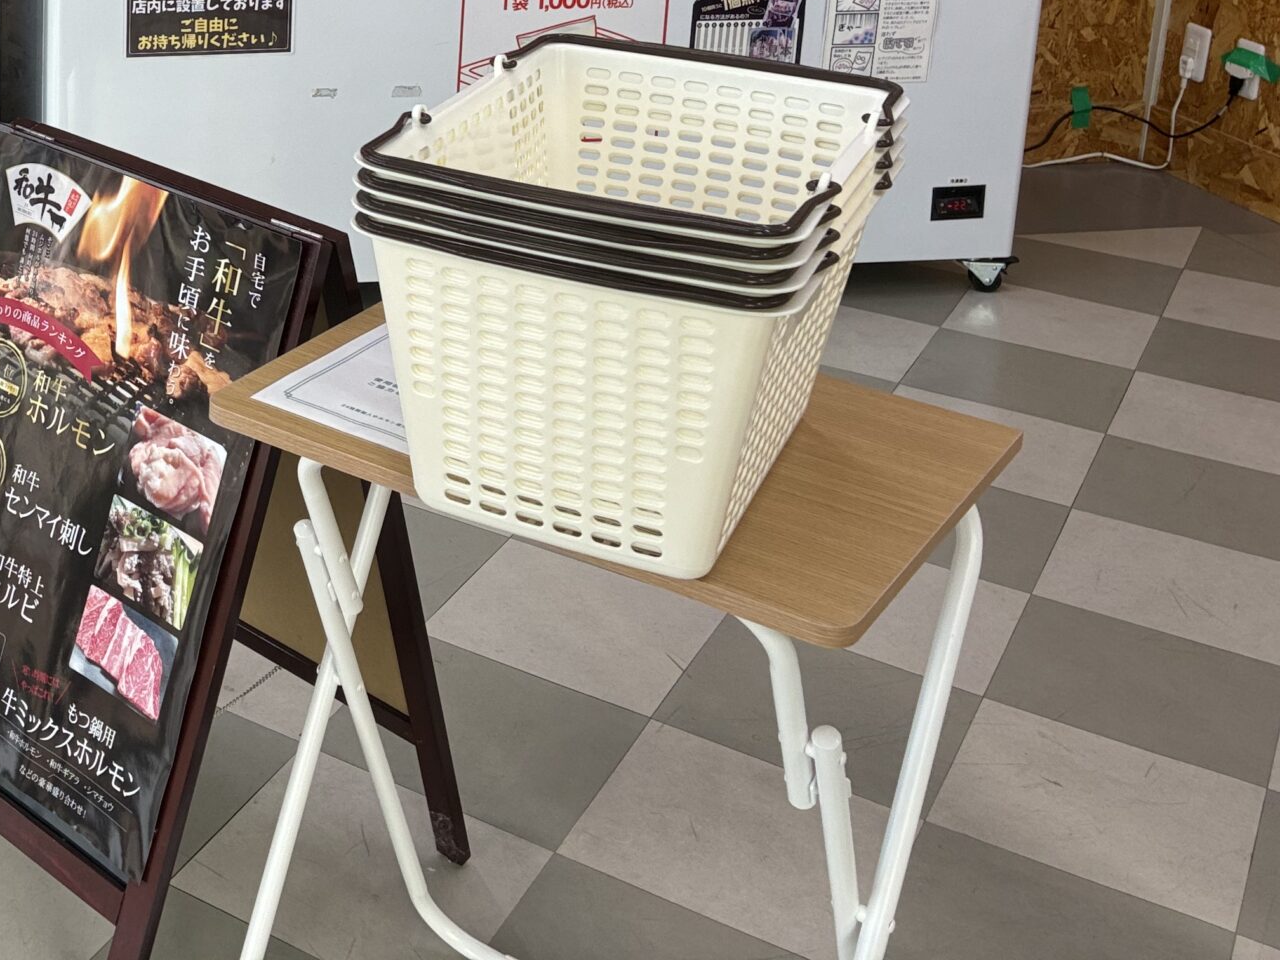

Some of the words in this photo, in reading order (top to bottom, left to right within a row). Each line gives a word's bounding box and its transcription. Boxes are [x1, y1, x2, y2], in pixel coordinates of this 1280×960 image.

[181, 18, 239, 33] ご自由に
[199, 240, 247, 371] 「和牛」を
[248, 252, 267, 310] 自宅で
[167, 225, 212, 405] お手頃に味わう。
[32, 370, 67, 401] 和牛
[26, 395, 115, 457] ホルモン
[12, 464, 41, 493] 和牛
[5, 487, 93, 556] センマイ刺し
[0, 687, 141, 798] 牛ミックスホルモン
[67, 703, 117, 750] もつ鍋用
